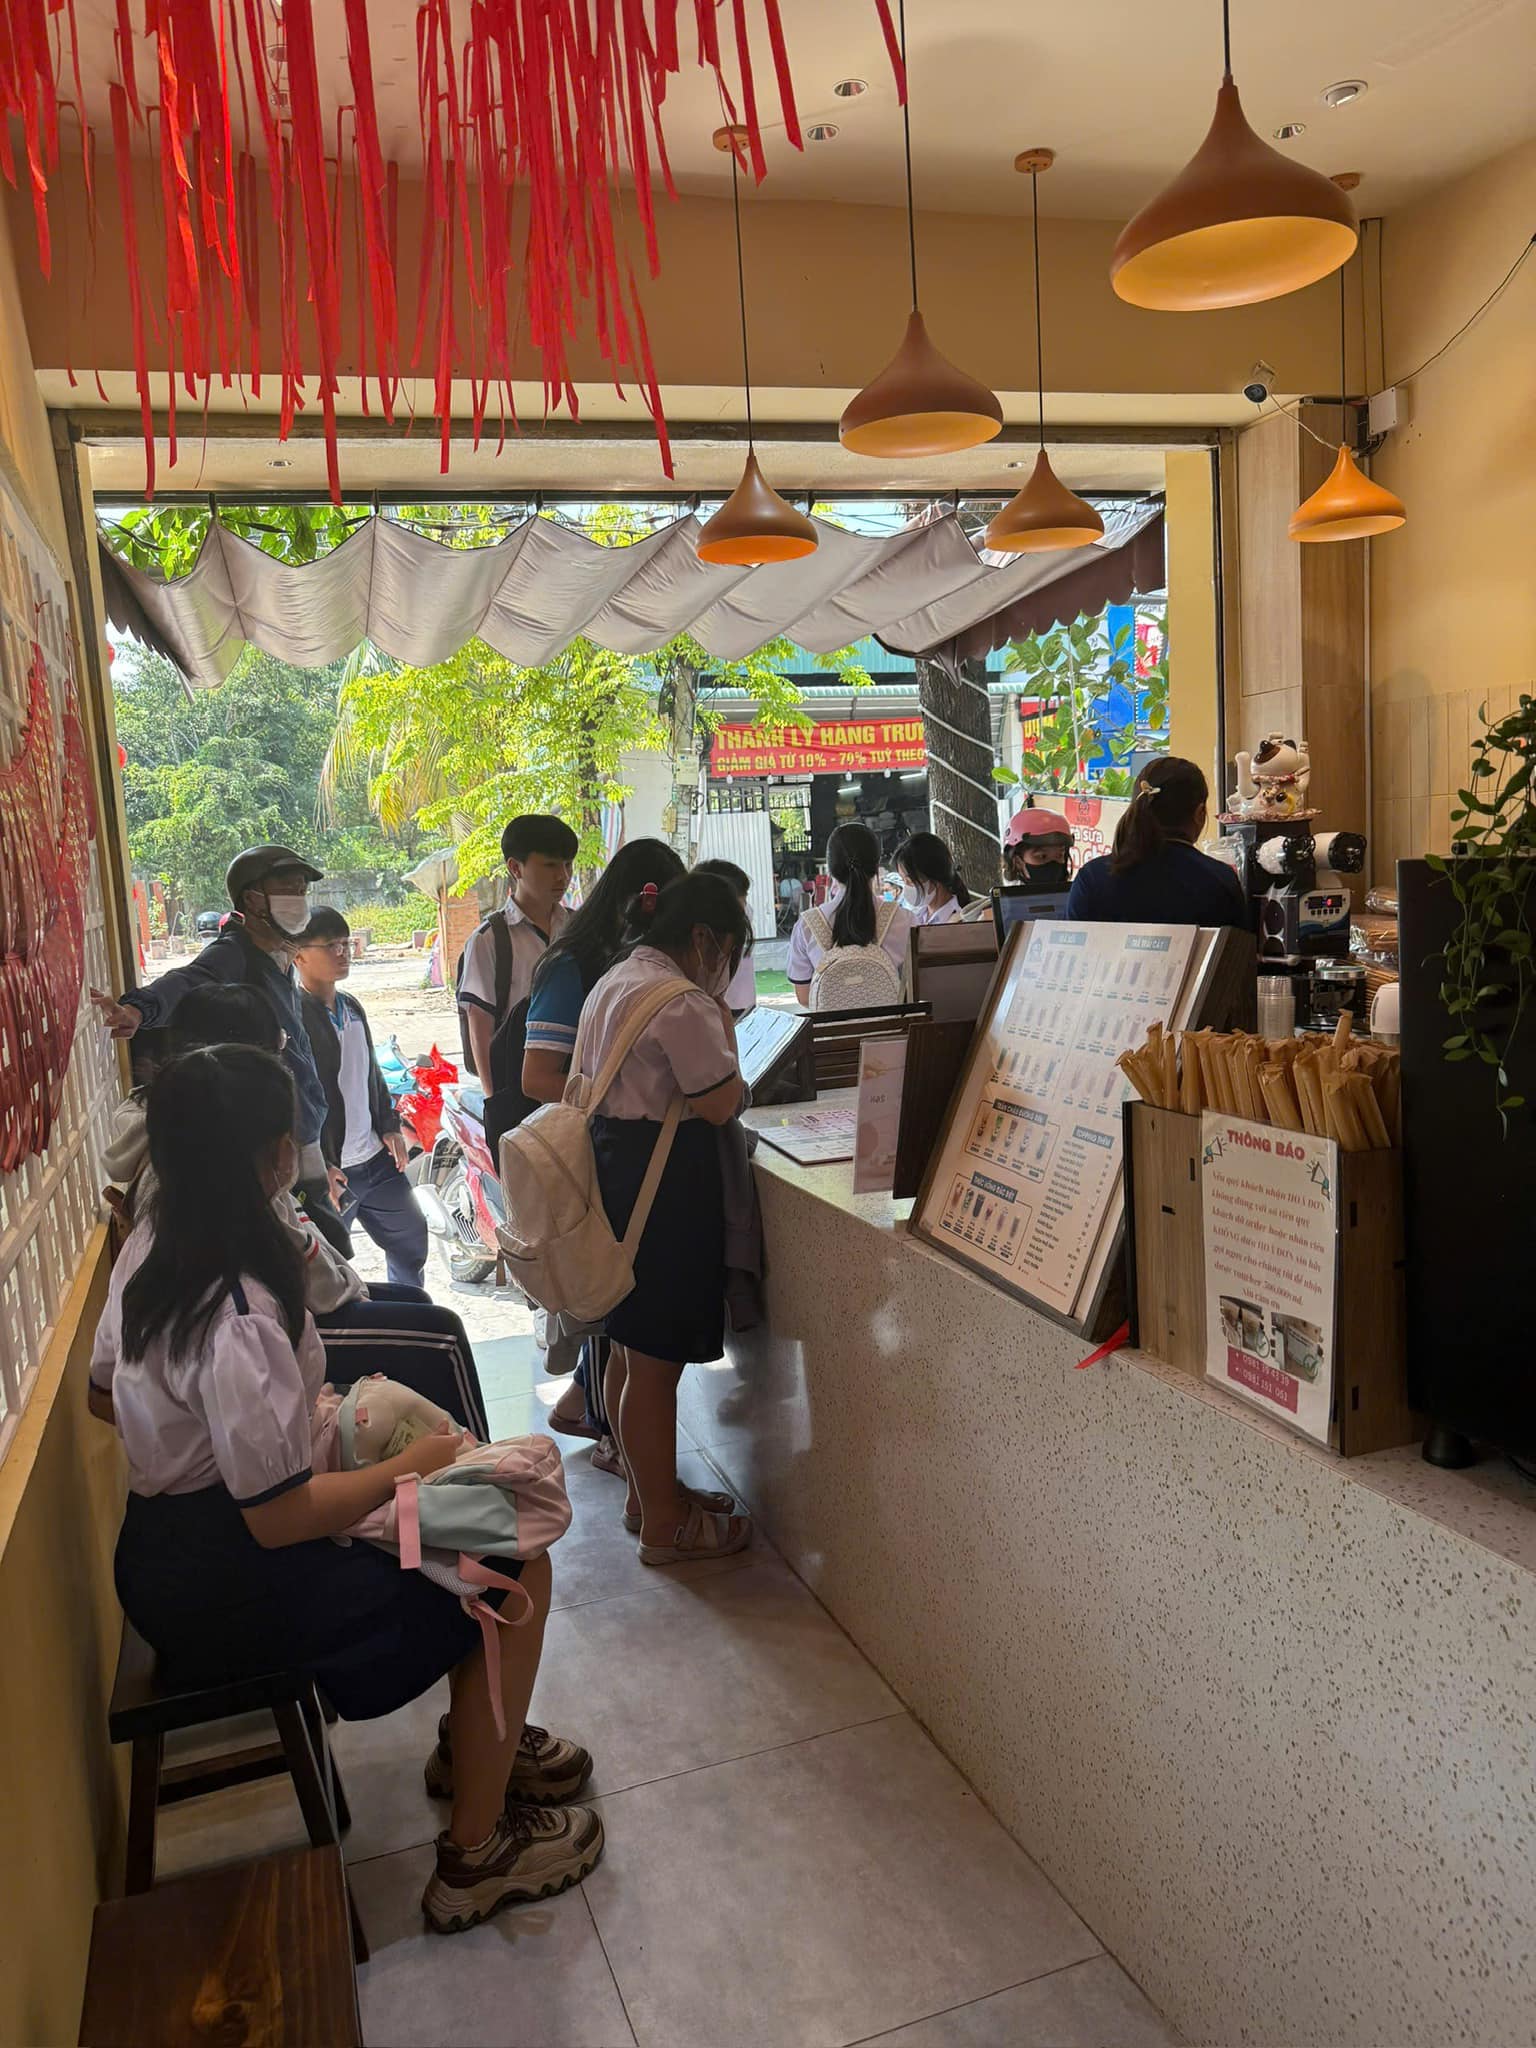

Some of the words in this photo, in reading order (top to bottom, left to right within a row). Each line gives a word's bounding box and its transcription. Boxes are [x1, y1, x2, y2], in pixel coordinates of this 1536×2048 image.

[755, 752, 776, 770] GIÁ
[780, 752, 796, 769] TỪ
[799, 752, 827, 768] 10%
[896, 748, 924, 762] THEO
[1226, 1129, 1272, 1153] THÔNG
[1275, 1141, 1306, 1161] BÁO
